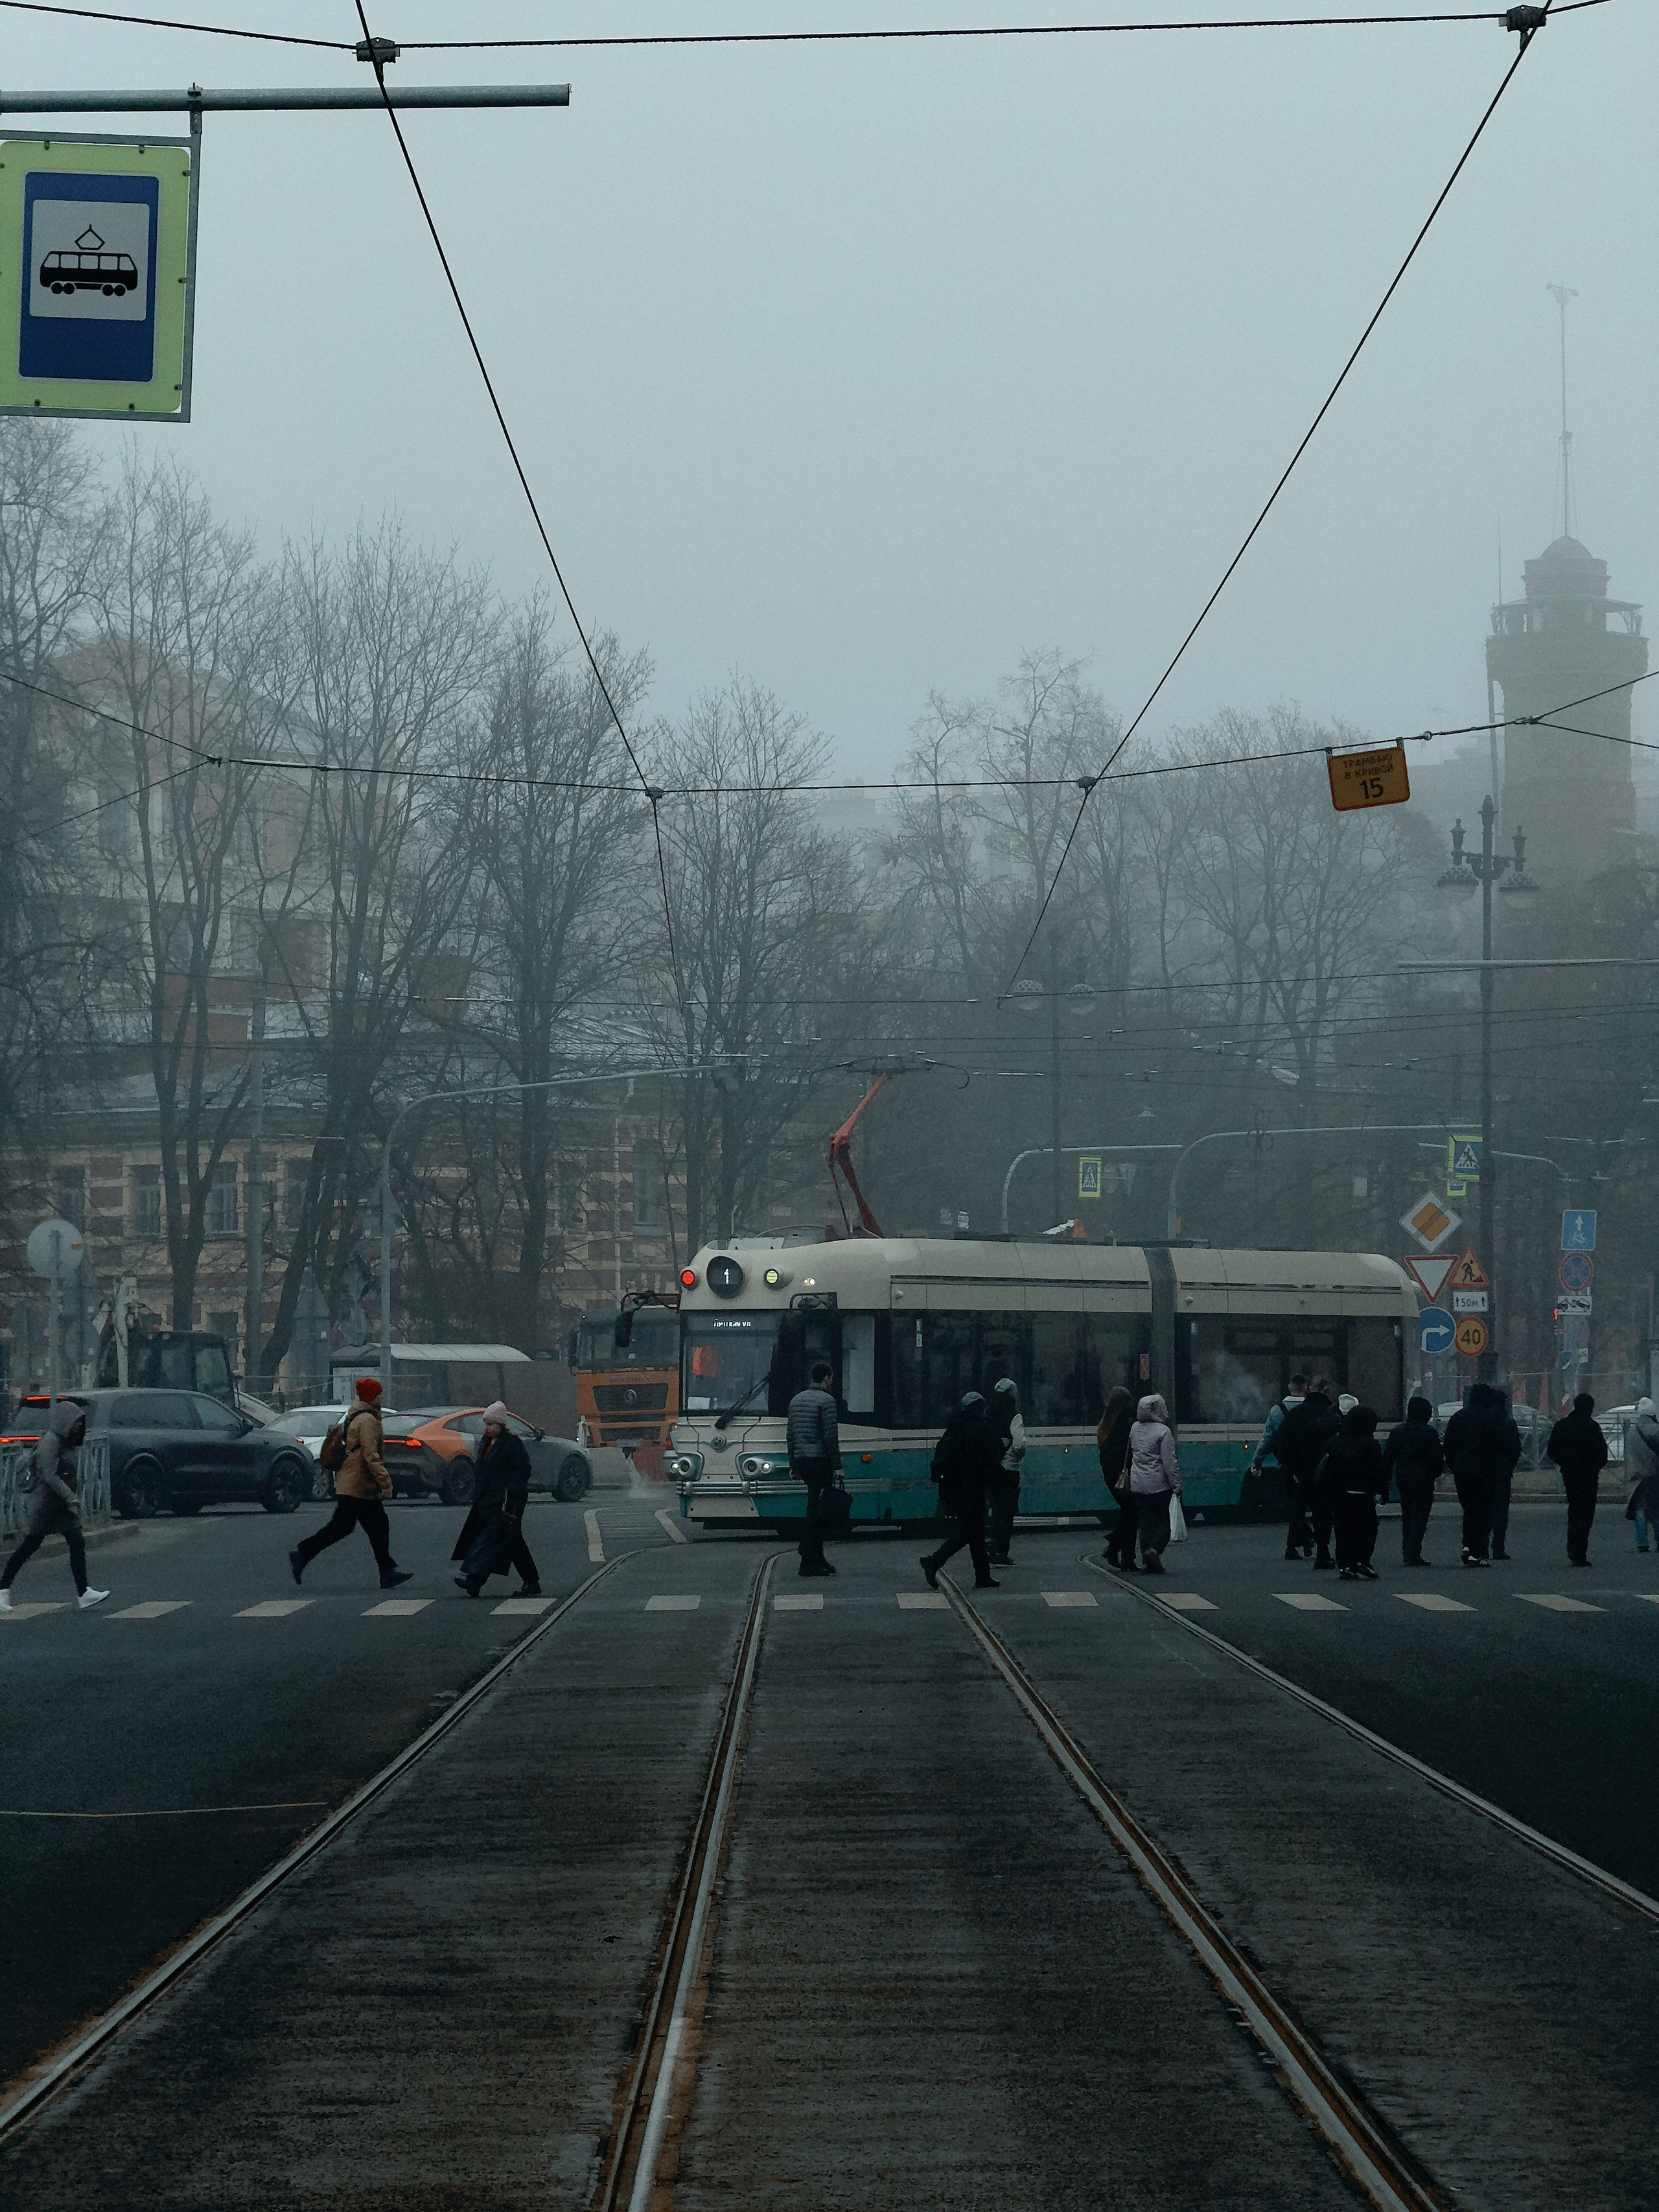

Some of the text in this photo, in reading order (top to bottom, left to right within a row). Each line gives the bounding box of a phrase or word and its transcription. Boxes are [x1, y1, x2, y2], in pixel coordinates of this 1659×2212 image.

[1344, 771, 1352, 780] В
[1360, 777, 1384, 799] 15
[1461, 1329, 1481, 1345] 40
